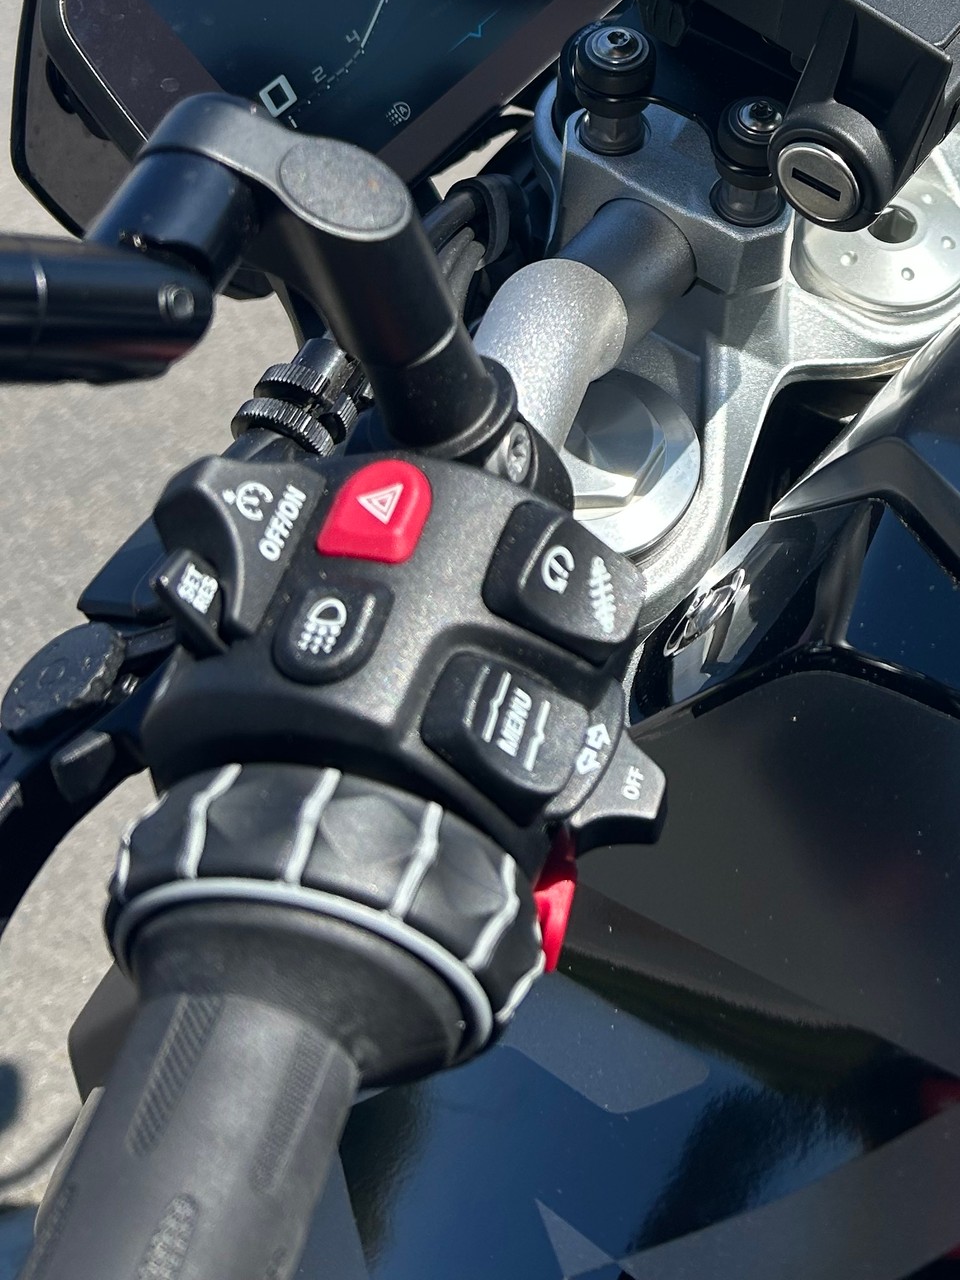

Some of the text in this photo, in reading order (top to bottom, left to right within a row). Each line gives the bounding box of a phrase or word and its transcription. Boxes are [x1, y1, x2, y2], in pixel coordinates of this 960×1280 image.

[345, 29, 361, 45] 4
[311, 65, 327, 84] 2
[259, 73, 298, 118] 0
[258, 484, 307, 562] OFF/ON
[177, 562, 203, 604] SET
[192, 575, 219, 614] RES
[496, 686, 532, 757] MENU
[621, 765, 645, 801] OFF
